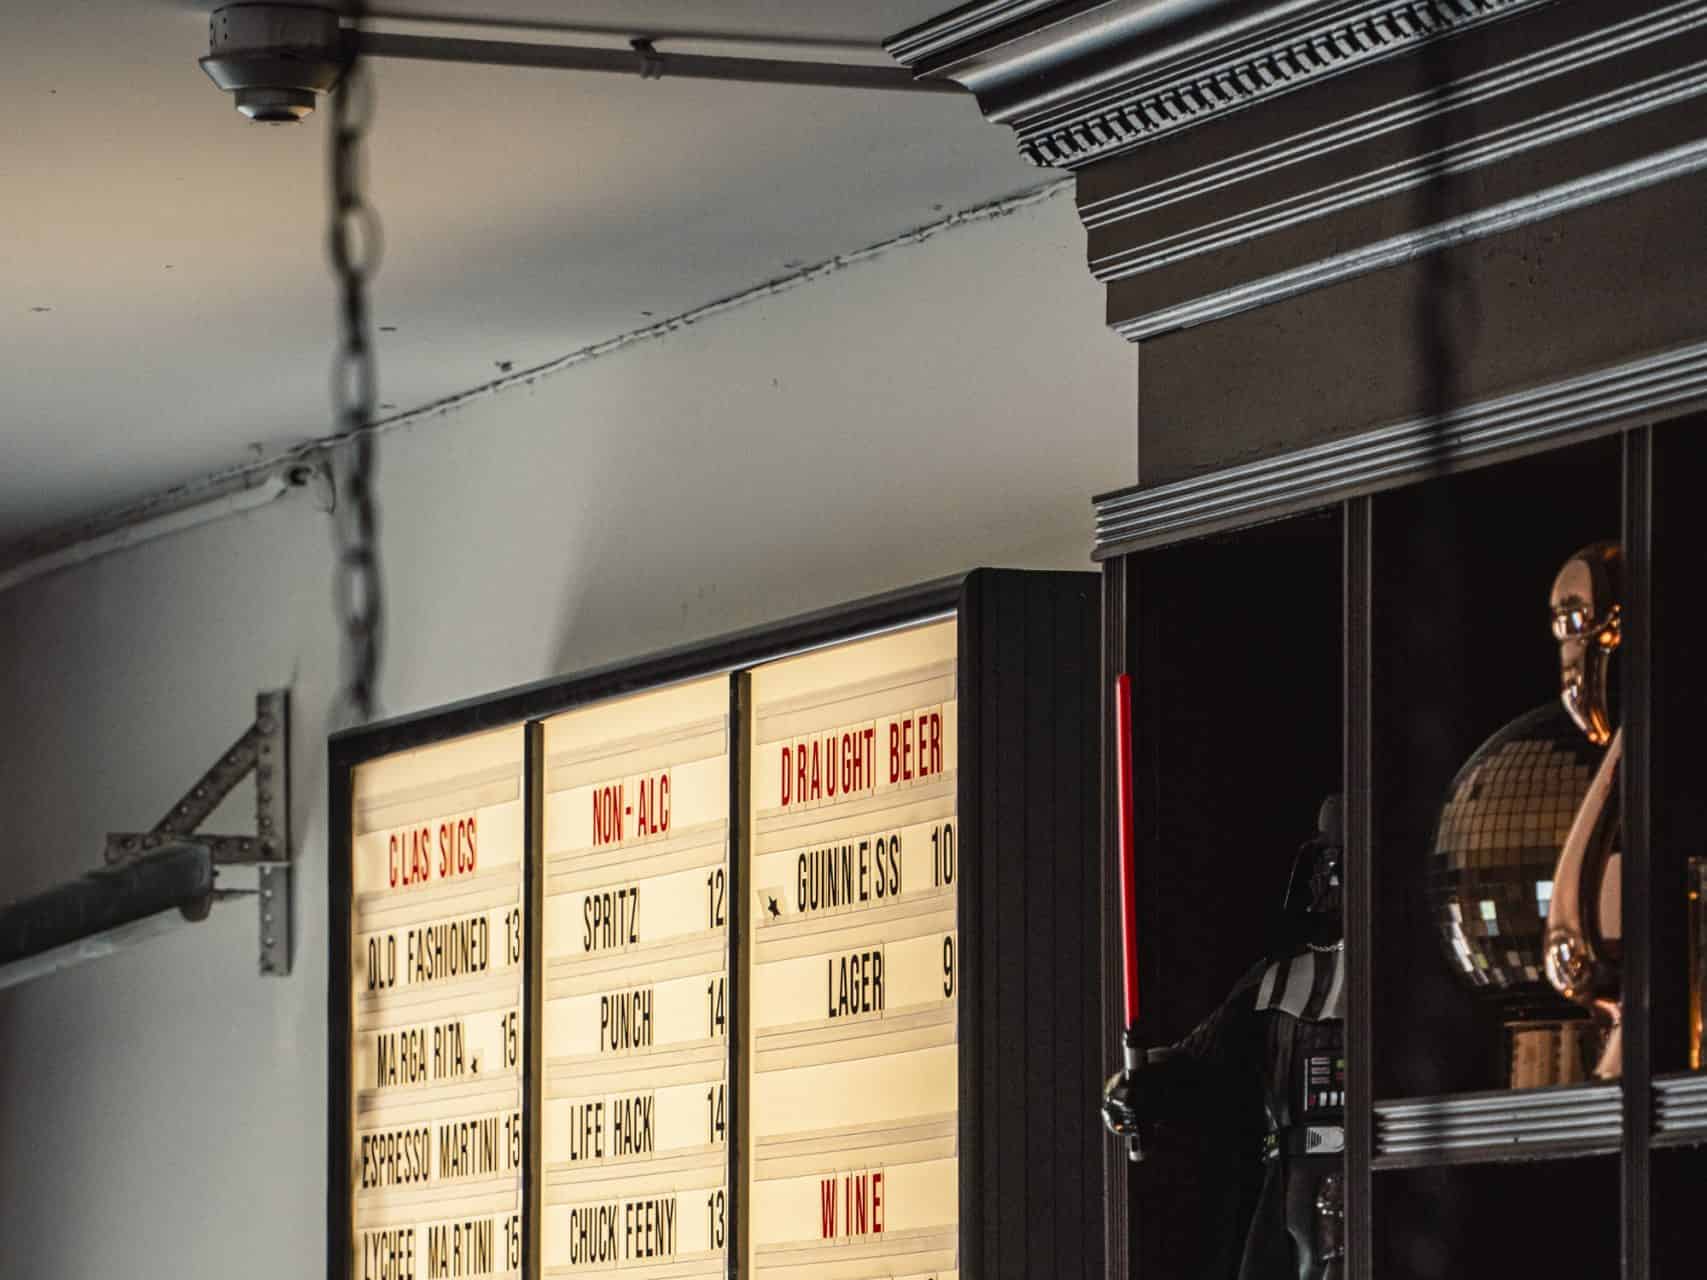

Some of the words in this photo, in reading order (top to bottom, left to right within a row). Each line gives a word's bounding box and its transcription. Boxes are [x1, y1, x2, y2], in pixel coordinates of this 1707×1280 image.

[781, 728, 874, 807] DRAUGHT
[890, 712, 942, 784] BEER
[798, 834, 901, 913] GUINNESS
[931, 823, 953, 888] 10
[368, 936, 395, 991] OLD
[408, 917, 489, 983] FASHIONED
[505, 907, 520, 964] 13
[583, 888, 639, 953] SPRITZ
[707, 870, 725, 928] 12
[600, 989, 652, 1052] PUNCH
[707, 978, 725, 1038] 14
[828, 951, 883, 1018] LAGER
[943, 936, 953, 999] 9
[501, 1012, 517, 1067] 15
[362, 1127, 430, 1188] ESPRESSO
[439, 1116, 499, 1178] MARTINI
[505, 1112, 520, 1168] 15
[570, 1101, 604, 1161] LIFE
[614, 1095, 653, 1157] HACK
[707, 1084, 725, 1144] 14
[570, 1203, 618, 1265] CHUCK
[626, 1197, 675, 1259] FEENY
[707, 1190, 725, 1250] 13
[821, 1173, 882, 1239] WINE
[428, 1219, 493, 1279] MARTINI
[504, 1215, 519, 1270] 15
